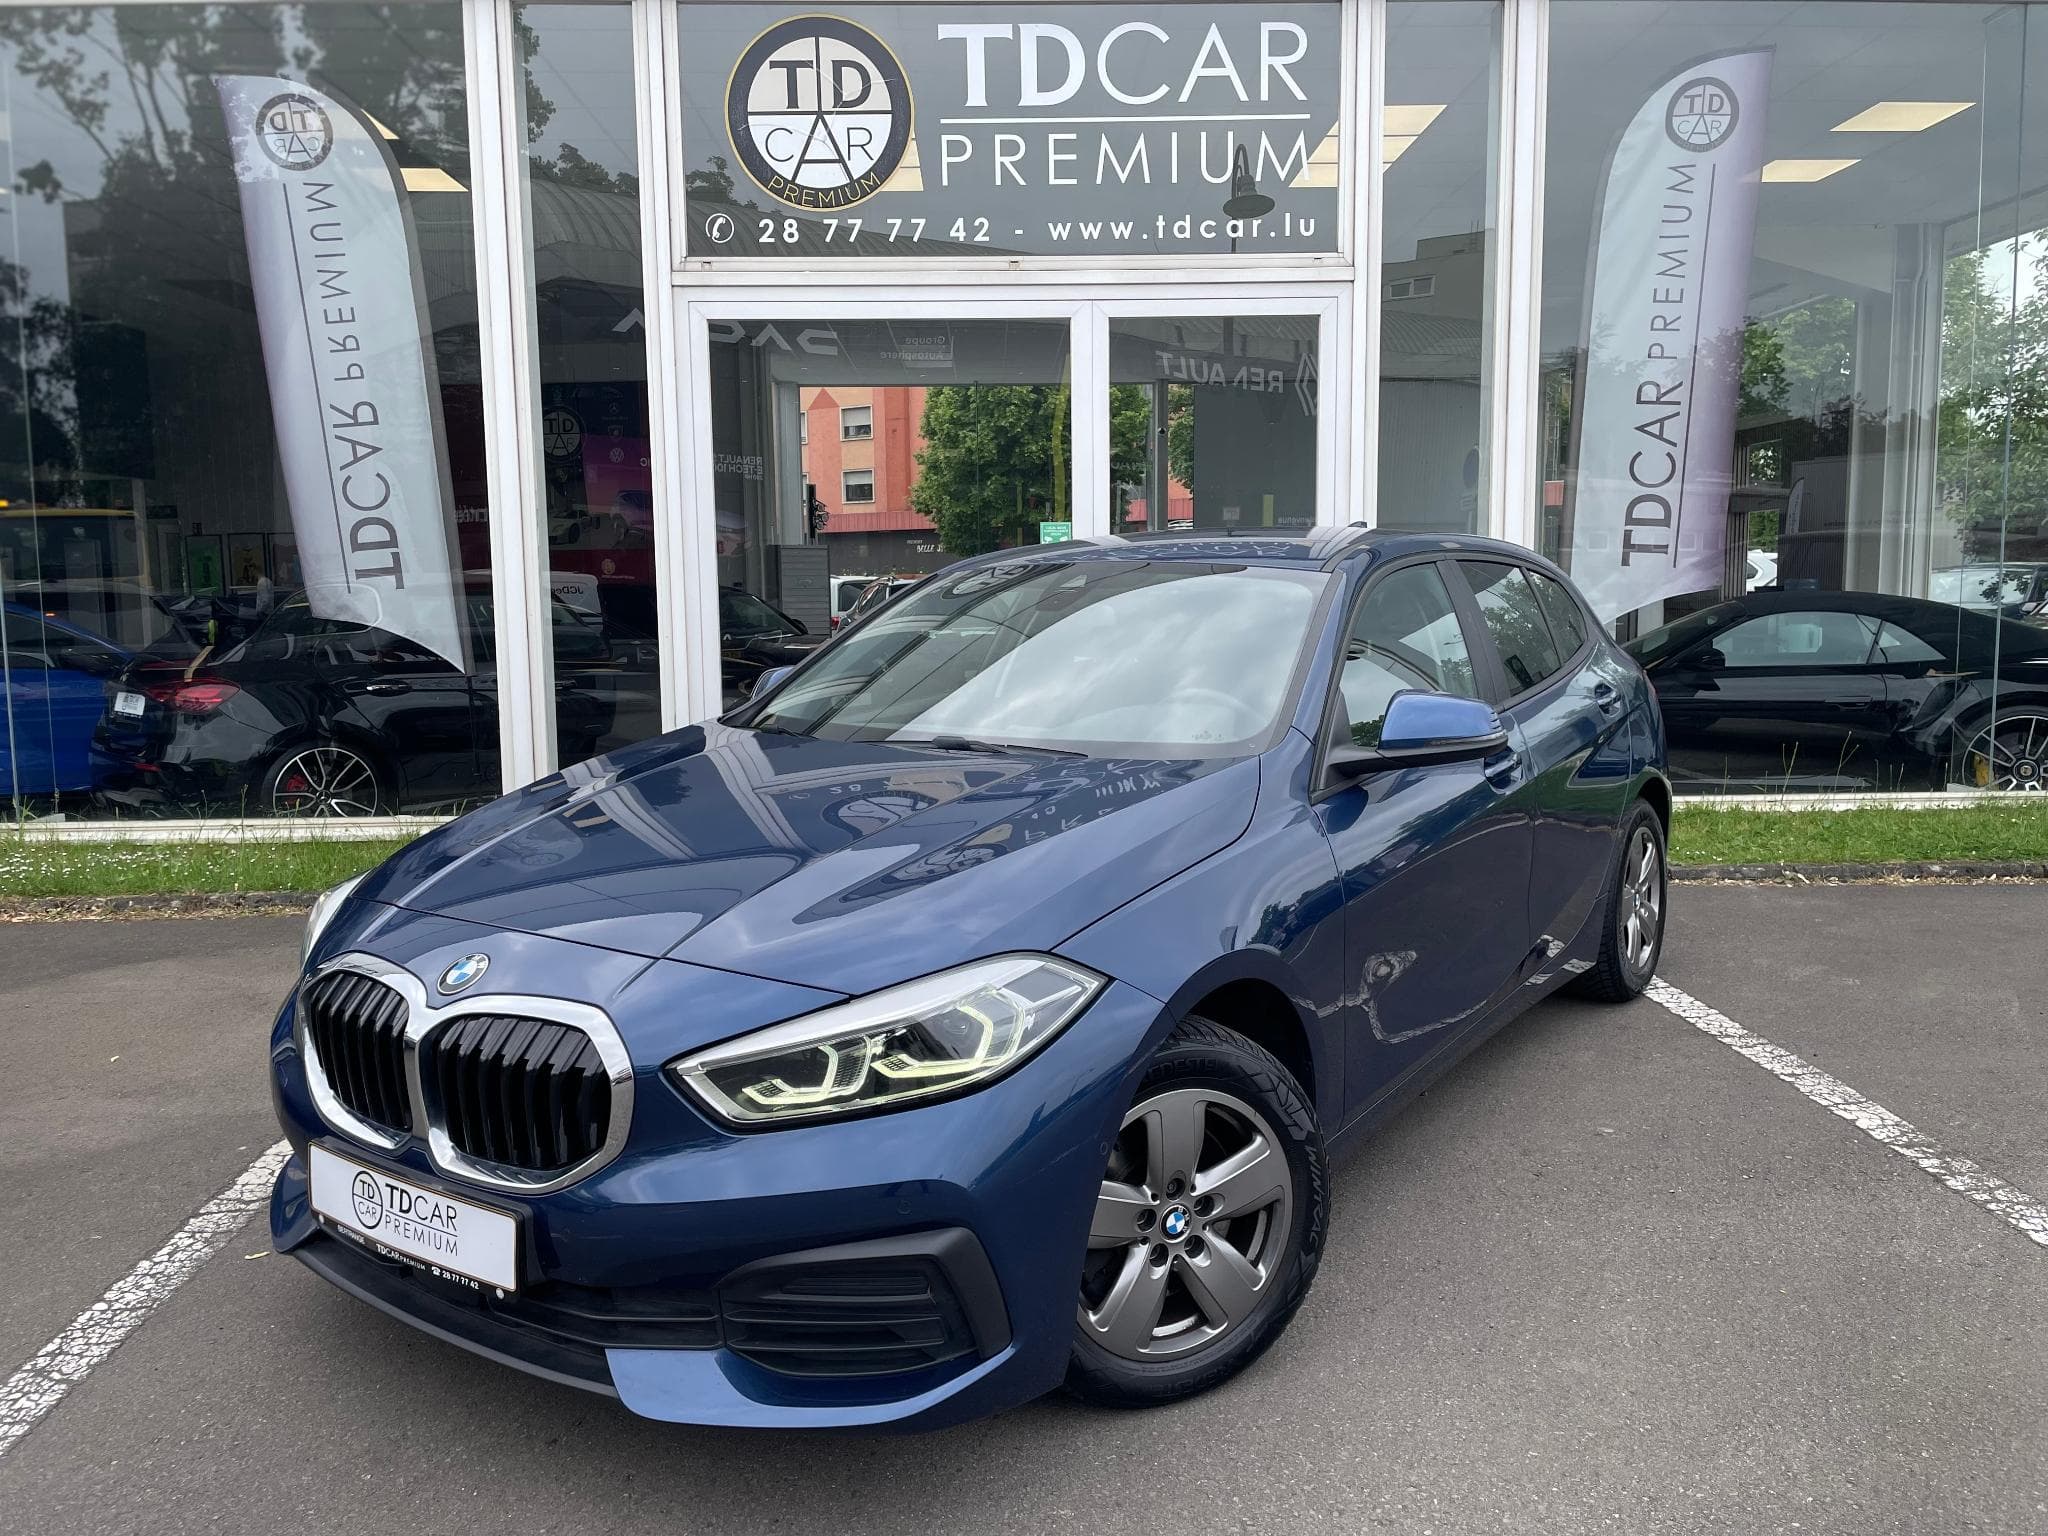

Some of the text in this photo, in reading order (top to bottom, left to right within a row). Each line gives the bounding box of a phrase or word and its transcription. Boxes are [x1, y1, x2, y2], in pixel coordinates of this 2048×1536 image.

[769, 60, 872, 109] TD
[937, 21, 1309, 107] TDCAR
[940, 130, 1311, 187] PREMIUM
[768, 172, 880, 208] PREMIUM
[758, 219, 799, 244] 28
[822, 219, 862, 243] 77
[886, 218, 926, 243] 77
[949, 217, 991, 242] 42
[1048, 213, 1316, 241] www.tdcar.lu
[1621, 164, 1697, 567] TDCAR PREMIUM
[358, 1201, 377, 1219] CAR
[359, 1179, 375, 1200] TD
[385, 1183, 457, 1231] TDCAR
[385, 1217, 458, 1257] PREMIUM
